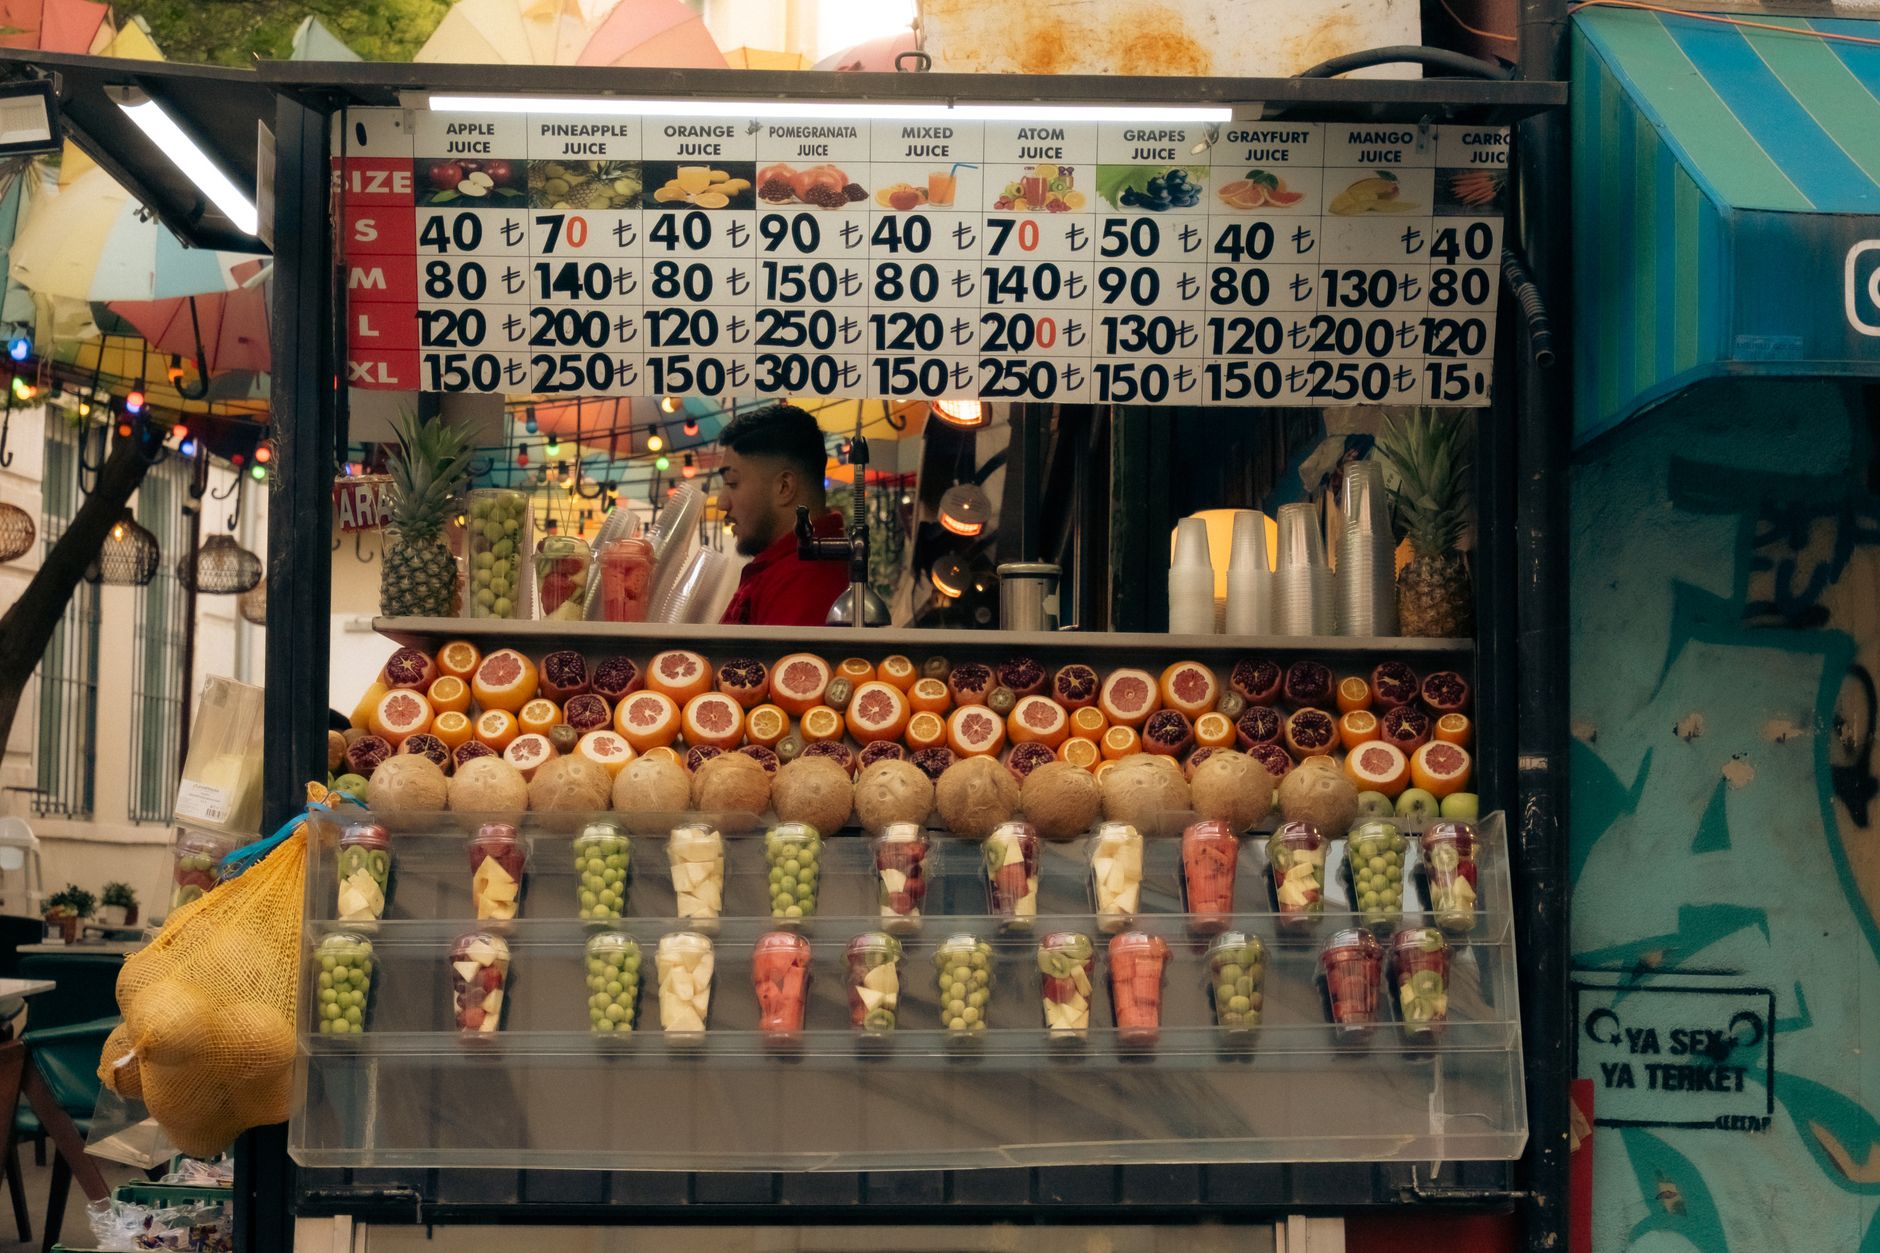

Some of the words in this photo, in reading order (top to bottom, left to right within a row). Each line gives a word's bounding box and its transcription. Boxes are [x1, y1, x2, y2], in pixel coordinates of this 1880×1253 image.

[446, 123, 495, 135] APPLE
[446, 141, 491, 153] JUICE
[541, 124, 628, 137] PINEAPPLE
[562, 142, 606, 154] JUICE
[664, 125, 734, 138] ORANGE
[769, 126, 857, 139] POMEGRANATA
[902, 127, 953, 140] MIXED
[1017, 128, 1065, 141] ATOM
[1124, 130, 1185, 142] GRAPES
[1227, 131, 1309, 144] GRAYFURT
[1348, 132, 1413, 145] MANGO
[677, 143, 721, 156] JUICE
[797, 144, 828, 156] JUICE
[905, 145, 949, 157] JUICE
[1018, 146, 1062, 159] JUICE
[1131, 148, 1176, 160] JUICE
[1245, 148, 1289, 161] JUICE
[1358, 150, 1402, 163] JUICE
[1470, 151, 1509, 164] JUIC
[354, 219, 378, 241] S
[419, 212, 482, 253] 40
[536, 214, 588, 254] 70
[649, 211, 711, 251] 40
[759, 212, 820, 254] 90
[872, 214, 931, 254] 40
[987, 218, 1039, 256] 70
[1100, 217, 1159, 257] 50
[1214, 222, 1274, 262] 40
[1431, 222, 1493, 265] 40
[350, 267, 387, 289] M
[425, 260, 486, 300] 80
[534, 261, 612, 300] 140
[652, 260, 713, 302] 80
[761, 261, 837, 303] 150
[874, 262, 939, 302] 80
[982, 263, 1061, 304] 140
[1099, 266, 1159, 306] 90
[1211, 267, 1269, 306] 80
[1320, 269, 1397, 308] 130
[1429, 268, 1489, 307] 80
[359, 315, 379, 336] L
[415, 308, 486, 348] 120
[528, 306, 610, 348] 200
[644, 308, 719, 348] 120
[754, 308, 836, 350] 250
[868, 313, 944, 351] 120
[980, 312, 1056, 353] 200
[1101, 314, 1176, 356] 130
[1208, 316, 1283, 356] 120
[1308, 314, 1394, 358] 200
[1421, 317, 1486, 358] 120
[348, 362, 398, 383] XL
[423, 352, 500, 392] 150
[531, 352, 614, 393] 250
[646, 353, 725, 396] 150
[754, 353, 838, 394] 300
[872, 357, 948, 398] 150
[979, 357, 1057, 399] 250
[1093, 363, 1168, 401] 150
[1204, 361, 1282, 401] 150
[1306, 360, 1390, 400] 250
[1626, 1027, 1660, 1054] YA
[1600, 1062, 1636, 1089] YA
